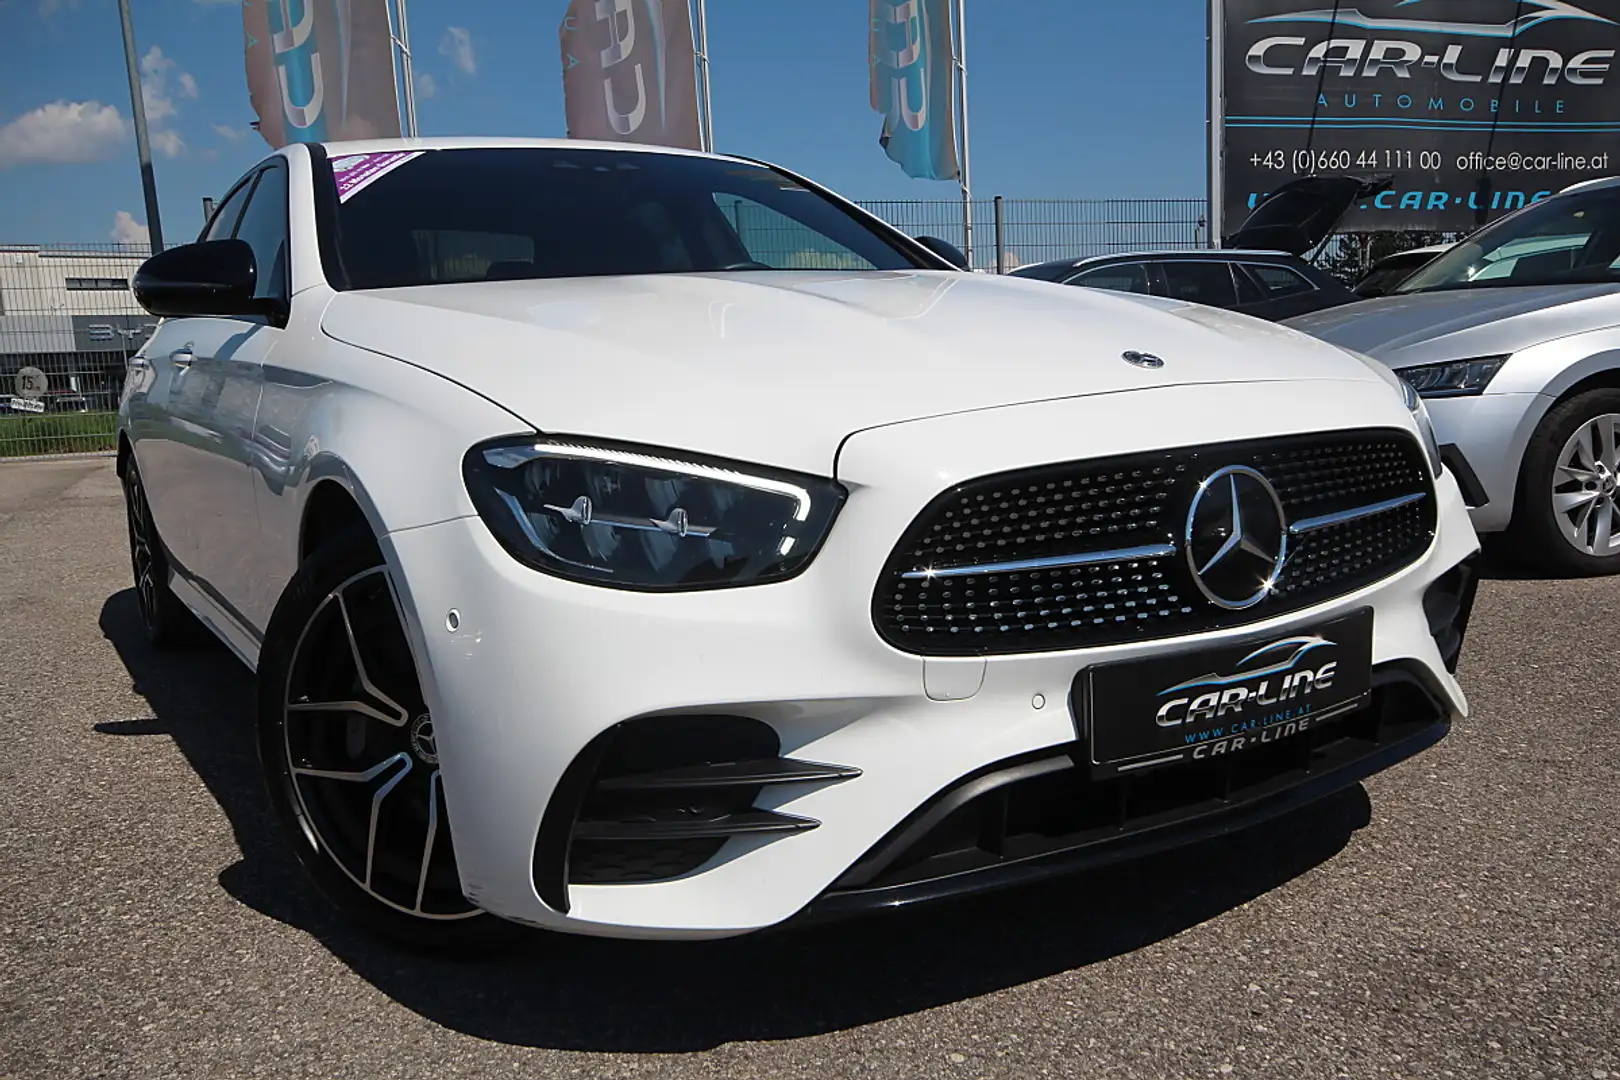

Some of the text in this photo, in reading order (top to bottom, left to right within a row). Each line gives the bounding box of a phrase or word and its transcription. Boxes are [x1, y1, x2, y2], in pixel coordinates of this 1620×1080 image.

[1316, 93, 1564, 113] AUTOMOBILE
[1249, 150, 1609, 174] +43 (0)660 44 111 00 office@car-line.at
